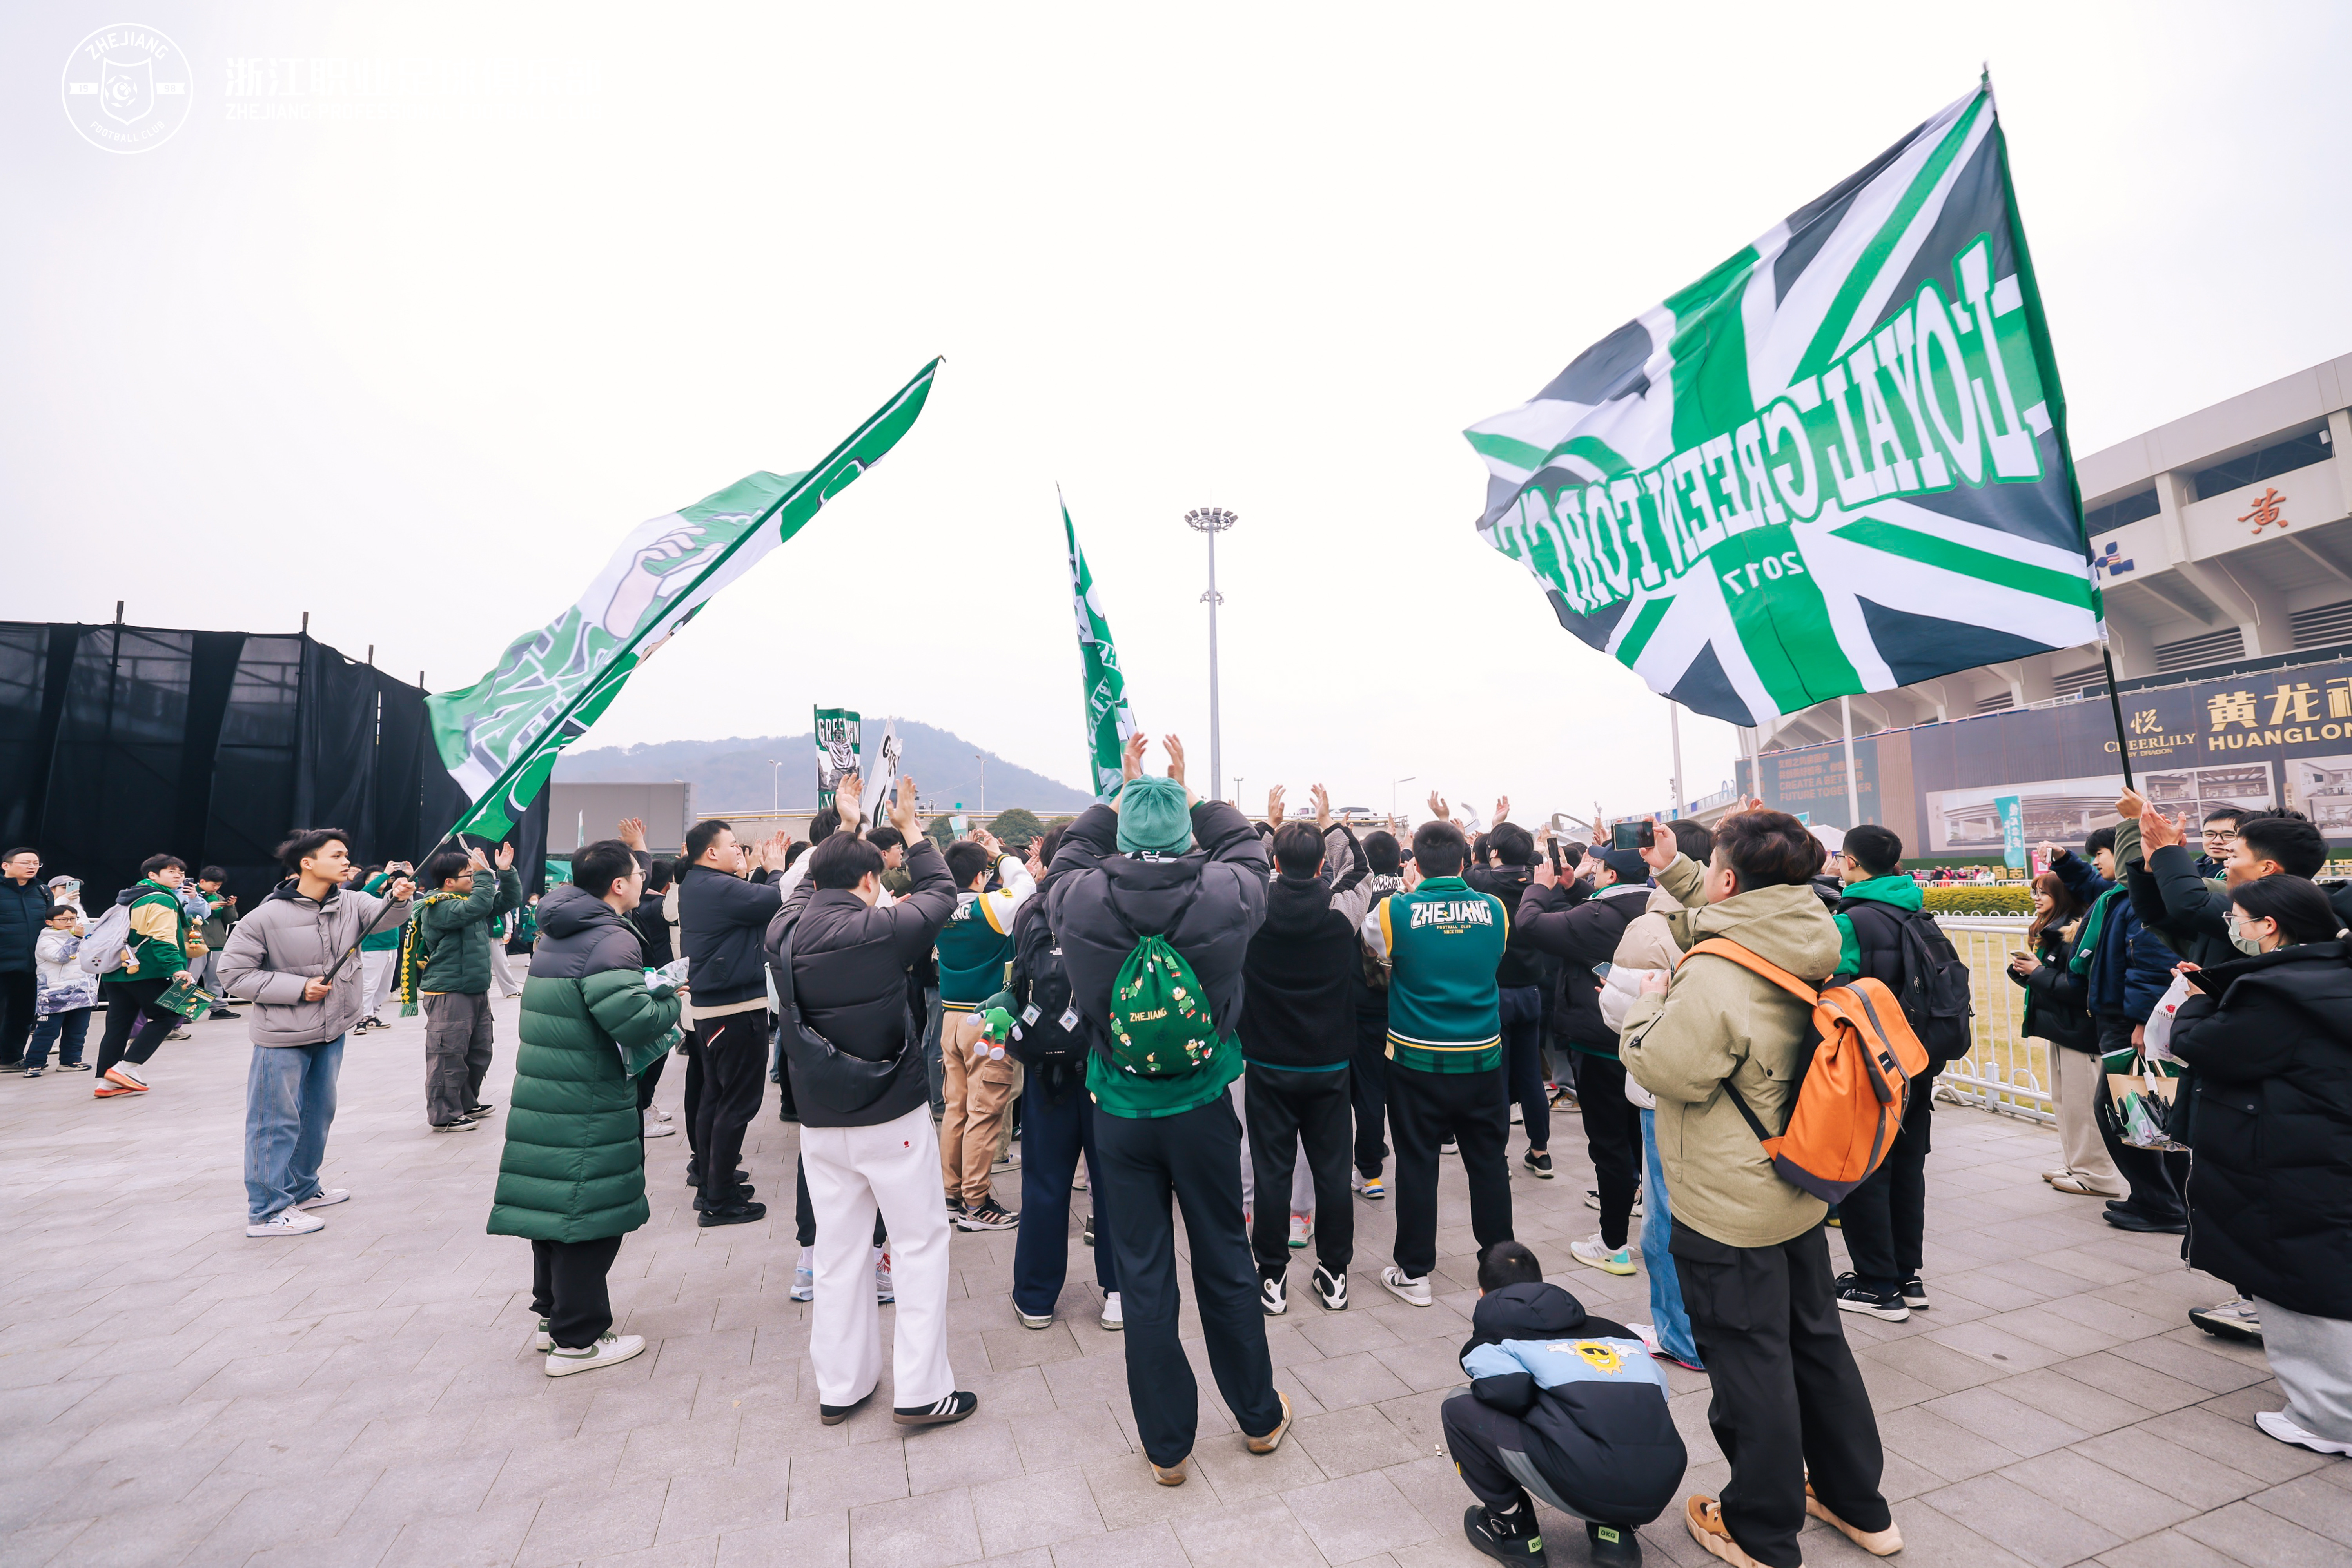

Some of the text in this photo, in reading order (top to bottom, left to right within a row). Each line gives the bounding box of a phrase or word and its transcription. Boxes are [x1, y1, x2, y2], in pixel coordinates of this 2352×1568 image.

[2237, 487, 2288, 535] 黄
[2140, 748, 2173, 757] DRAGON
[1779, 778, 1815, 791] CREATE
[1816, 777, 1823, 787] A
[1824, 771, 1864, 786] BETTR
[1780, 782, 1873, 802] FUTURE TOGETER
[1411, 901, 1493, 929] ZHEJIANG
[1129, 1007, 1168, 1022] ZHEJIANG
